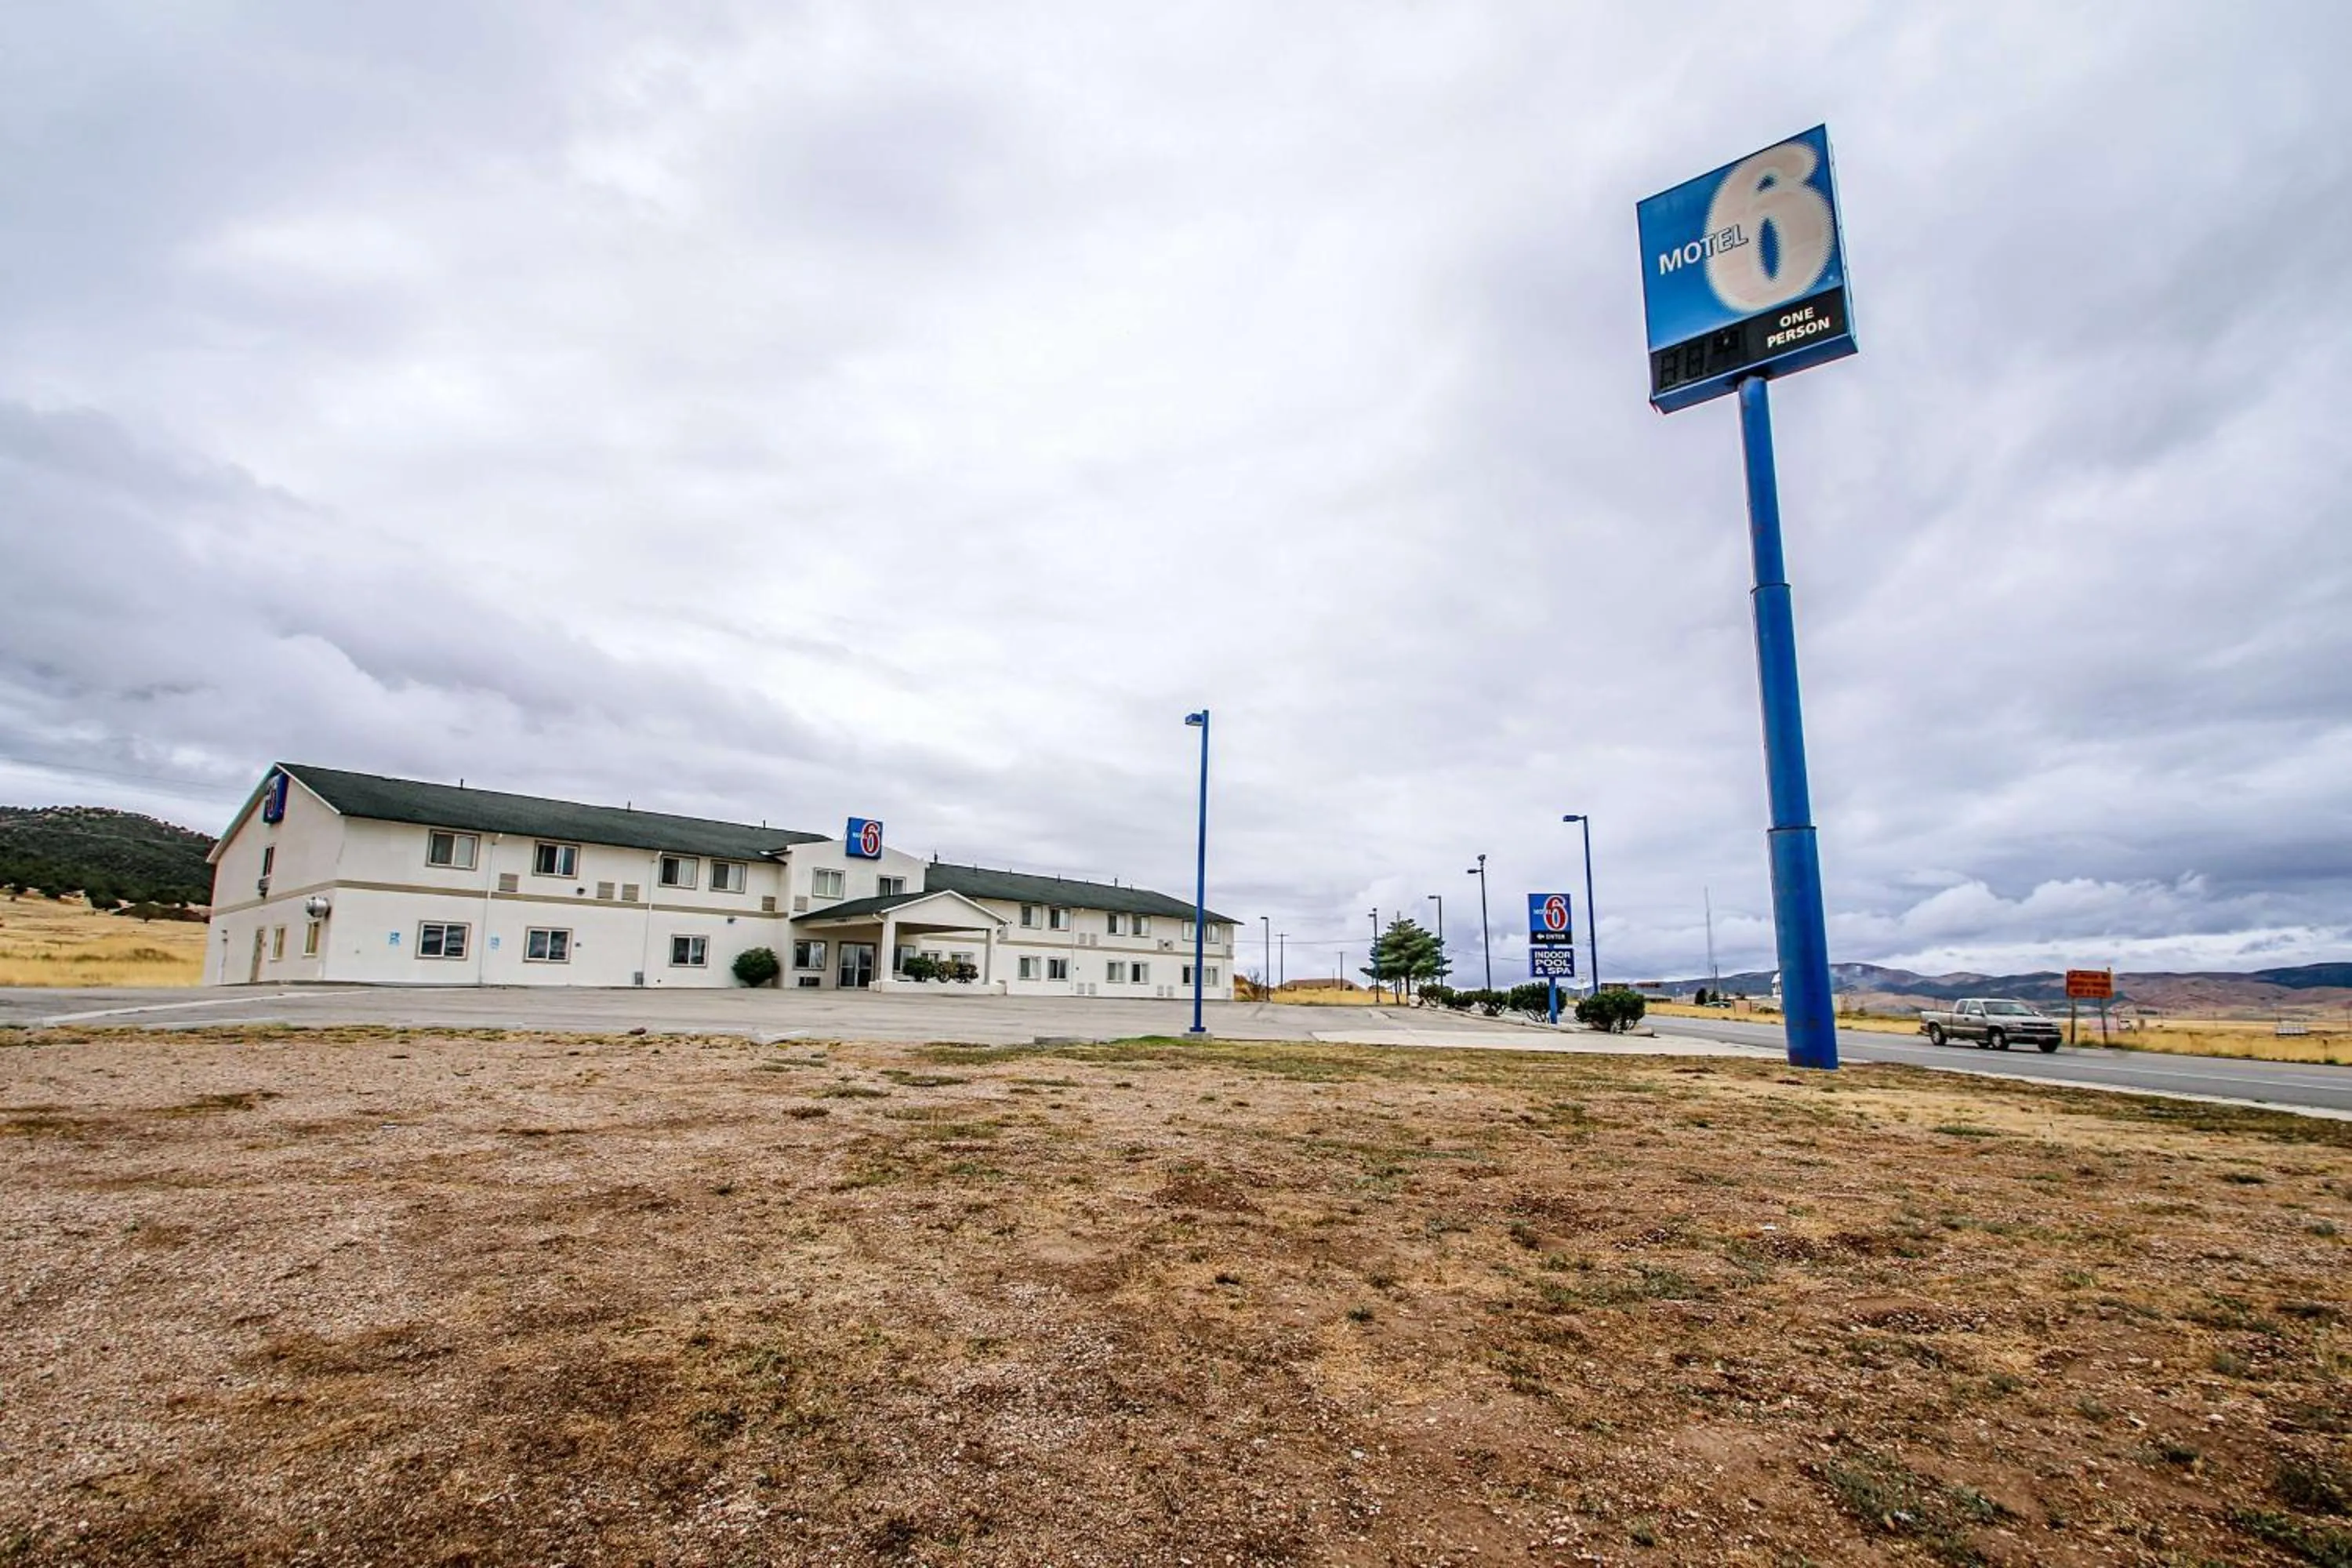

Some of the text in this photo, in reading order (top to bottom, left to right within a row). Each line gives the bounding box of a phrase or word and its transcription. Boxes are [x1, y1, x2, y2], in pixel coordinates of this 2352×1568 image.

[1658, 140, 1835, 313] MOTEL 6
[1766, 316, 1831, 349] PERSON
[1779, 306, 1815, 328] ONE
[861, 822, 880, 856] 6
[1543, 895, 1569, 931] 6
